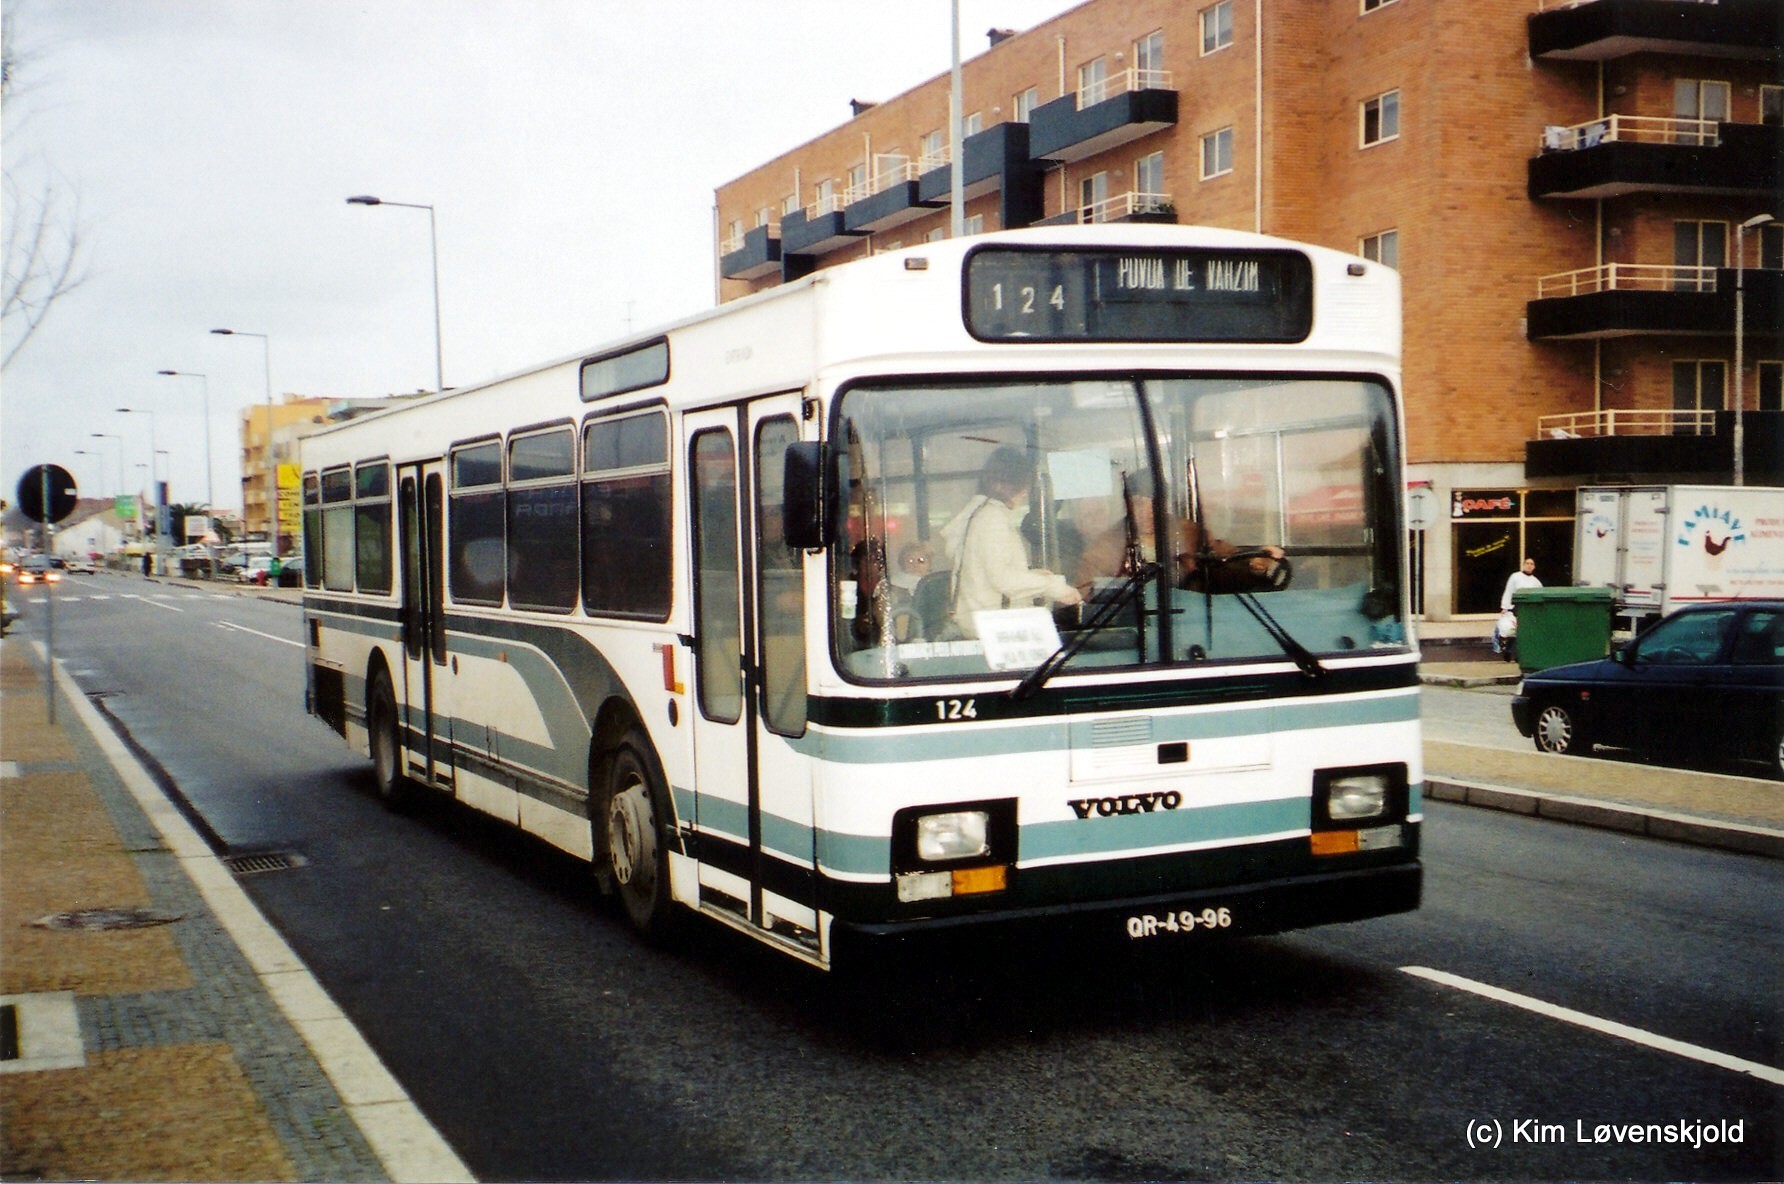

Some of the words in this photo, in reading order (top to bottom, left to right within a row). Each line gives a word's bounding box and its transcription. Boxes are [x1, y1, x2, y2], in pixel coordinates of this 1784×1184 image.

[1174, 259, 1195, 290] DE
[935, 699, 977, 720] 124
[1067, 790, 1183, 819] VOLVO
[1127, 907, 1232, 938] QR-49-96
